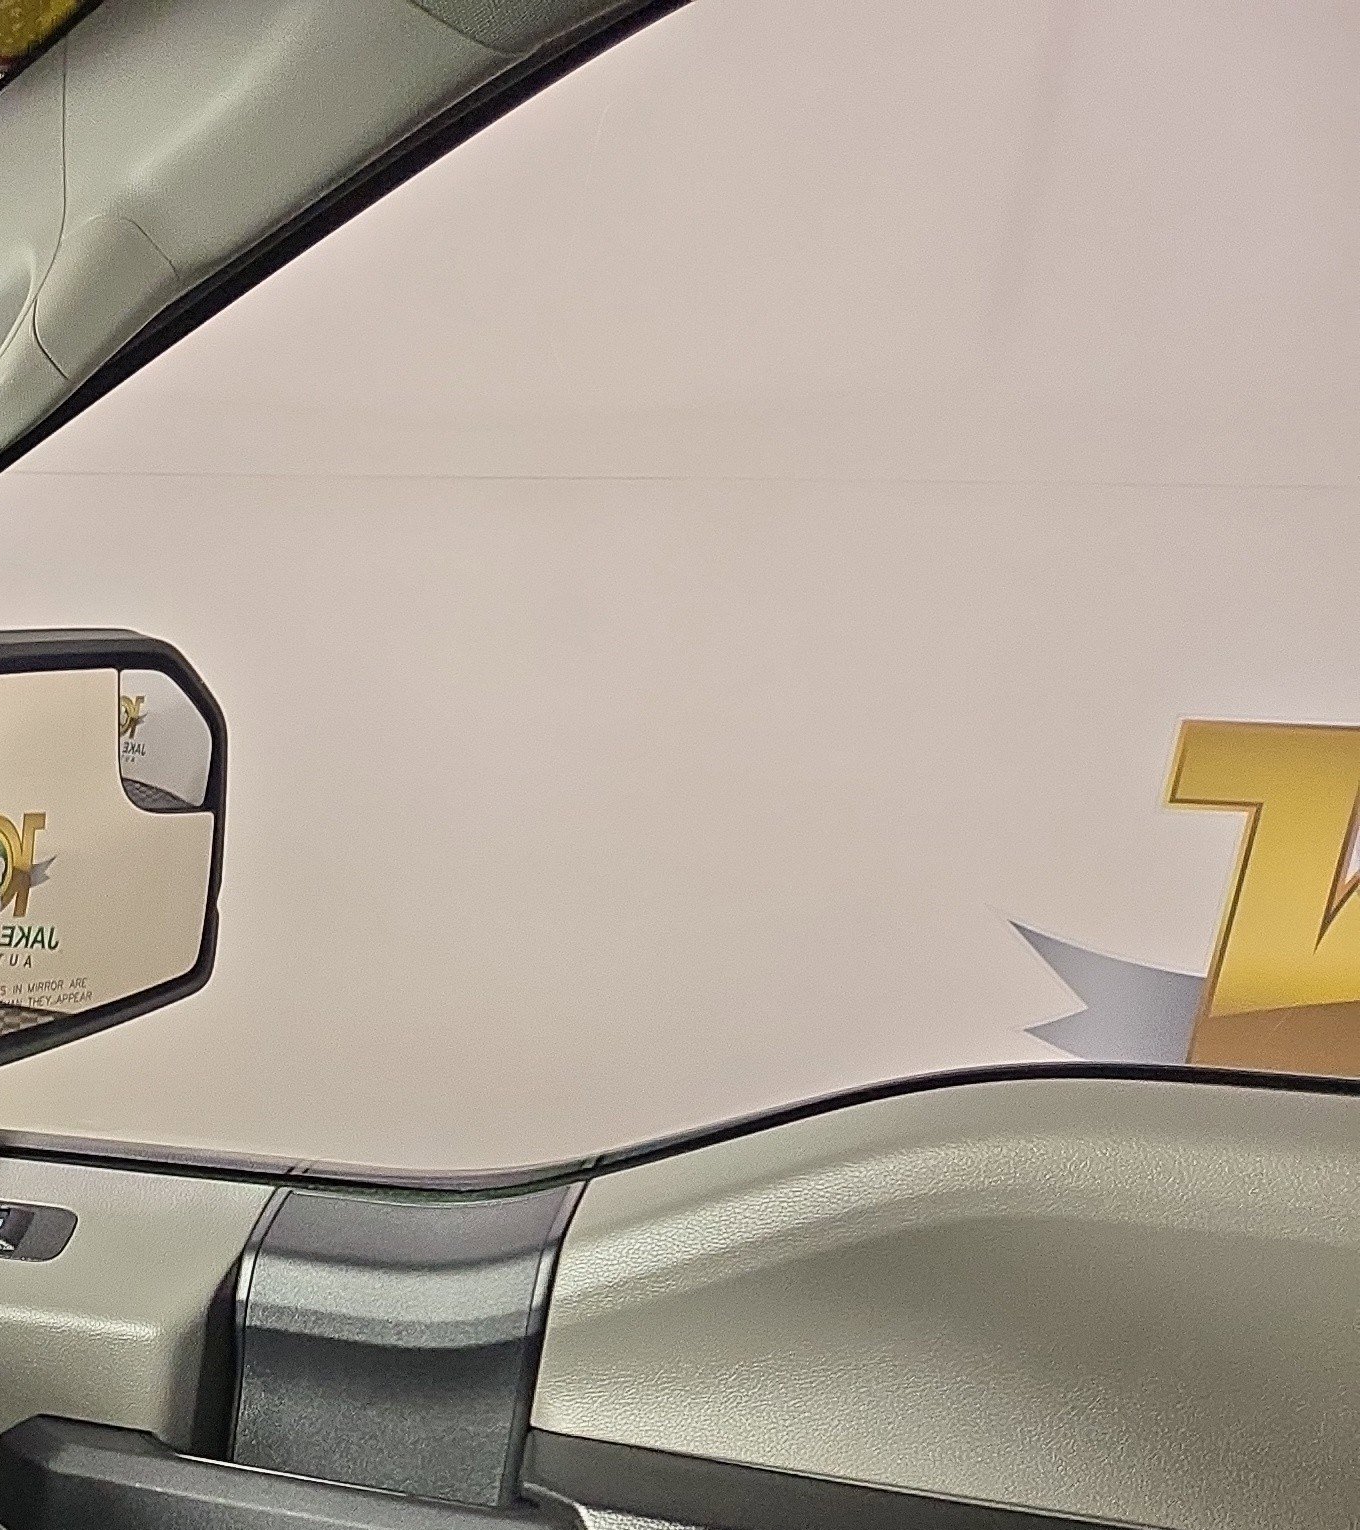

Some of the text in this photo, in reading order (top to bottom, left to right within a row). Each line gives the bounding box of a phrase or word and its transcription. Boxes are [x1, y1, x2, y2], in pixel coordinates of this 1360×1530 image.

[12, 983, 23, 994] IN
[27, 979, 64, 993] MIRROR
[68, 977, 88, 989] ARE
[55, 990, 93, 1005] APPEAR
